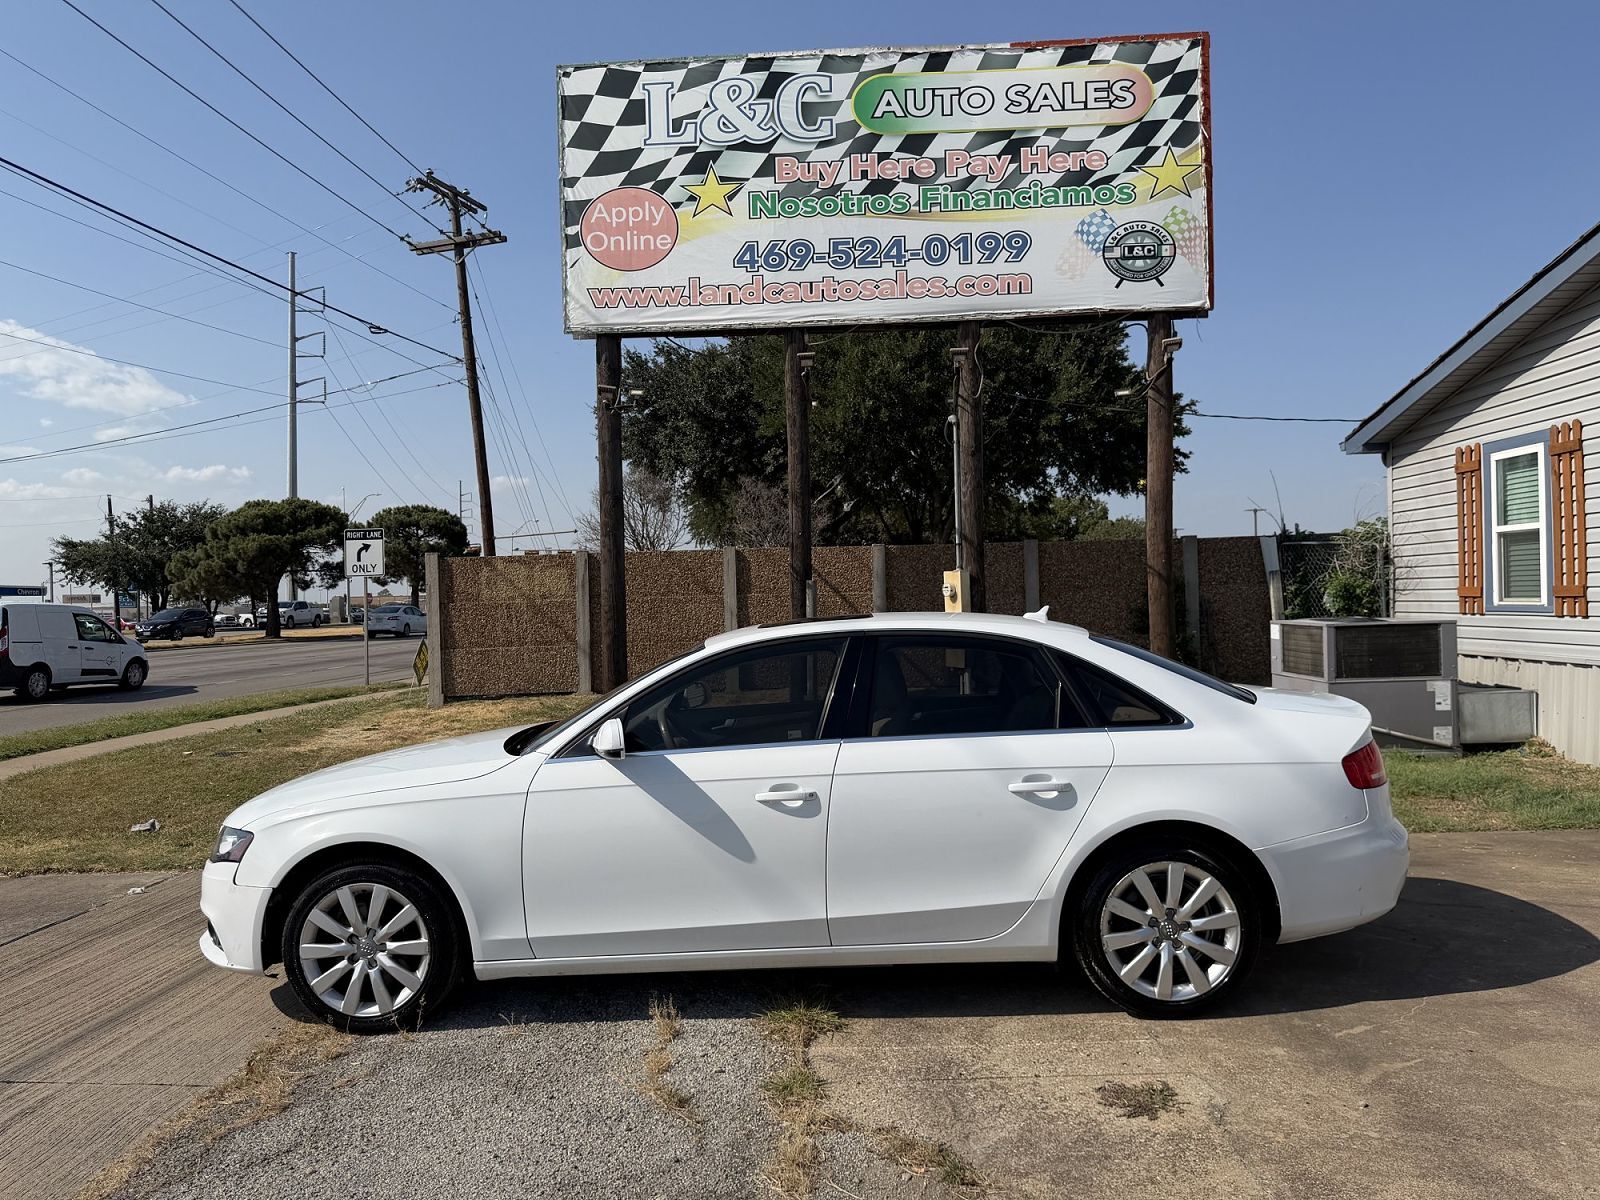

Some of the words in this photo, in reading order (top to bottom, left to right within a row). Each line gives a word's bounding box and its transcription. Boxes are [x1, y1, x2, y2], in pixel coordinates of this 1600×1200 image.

[642, 73, 837, 147] L&C
[871, 86, 995, 119] AUTO
[1005, 79, 1136, 114] SALES
[774, 156, 844, 189] Buy
[850, 152, 936, 180] Here
[944, 149, 1011, 182] Pay
[1020, 146, 1108, 175] Here
[590, 201, 665, 227] Apply
[748, 190, 911, 219] Nosotros
[918, 180, 1137, 214] Financiamos
[586, 231, 672, 252] Online
[1108, 232, 1122, 245] L&C
[1123, 223, 1147, 233] AUTO
[1149, 226, 1170, 243] SALES
[733, 230, 1032, 272] 469-524-0199
[1124, 246, 1155, 257] L&C
[587, 272, 1033, 308] www.landcautosales.com
[346, 531, 364, 539] RIGHT
[352, 563, 377, 573] ONLY
